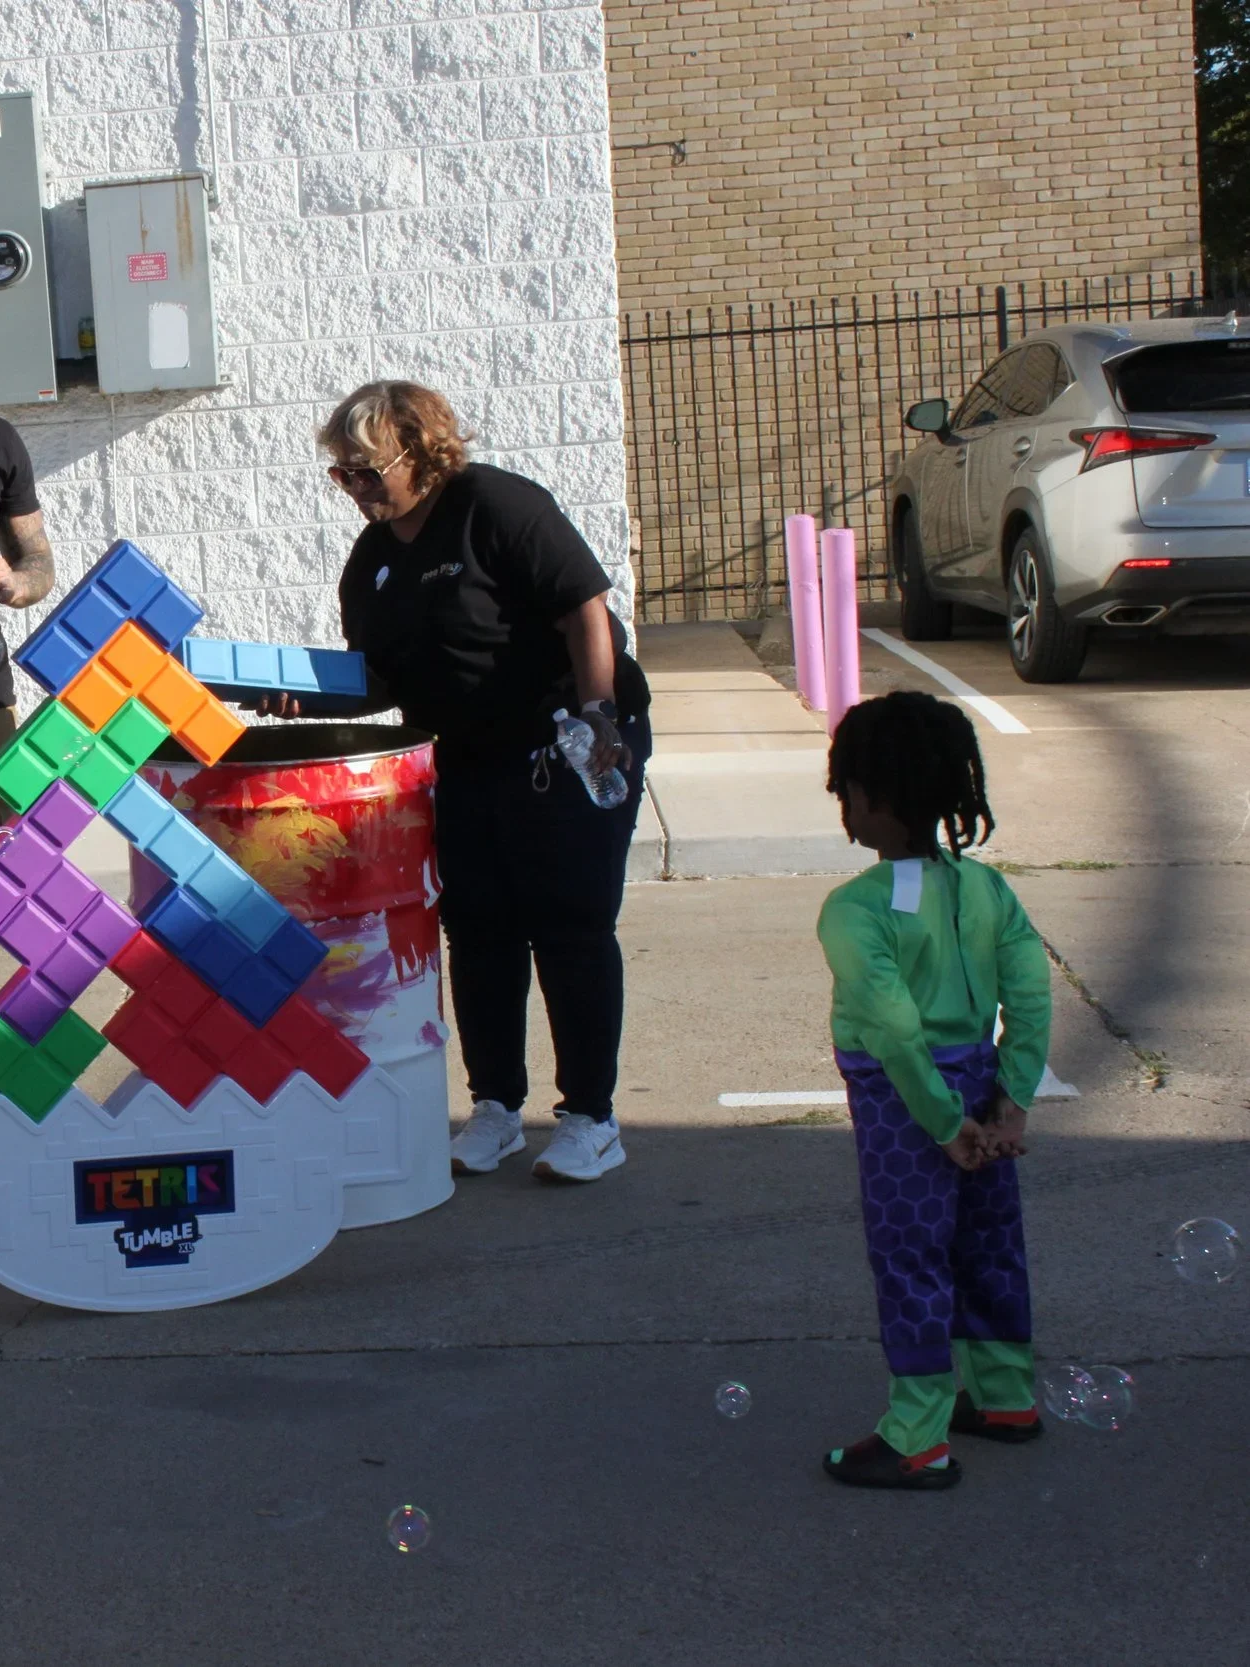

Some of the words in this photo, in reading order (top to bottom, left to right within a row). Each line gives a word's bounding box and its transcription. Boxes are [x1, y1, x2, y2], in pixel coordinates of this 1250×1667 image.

[87, 1164, 221, 1212] TETRIS
[119, 1222, 194, 1252] TUMBLE
[178, 1242, 195, 1254] XL
